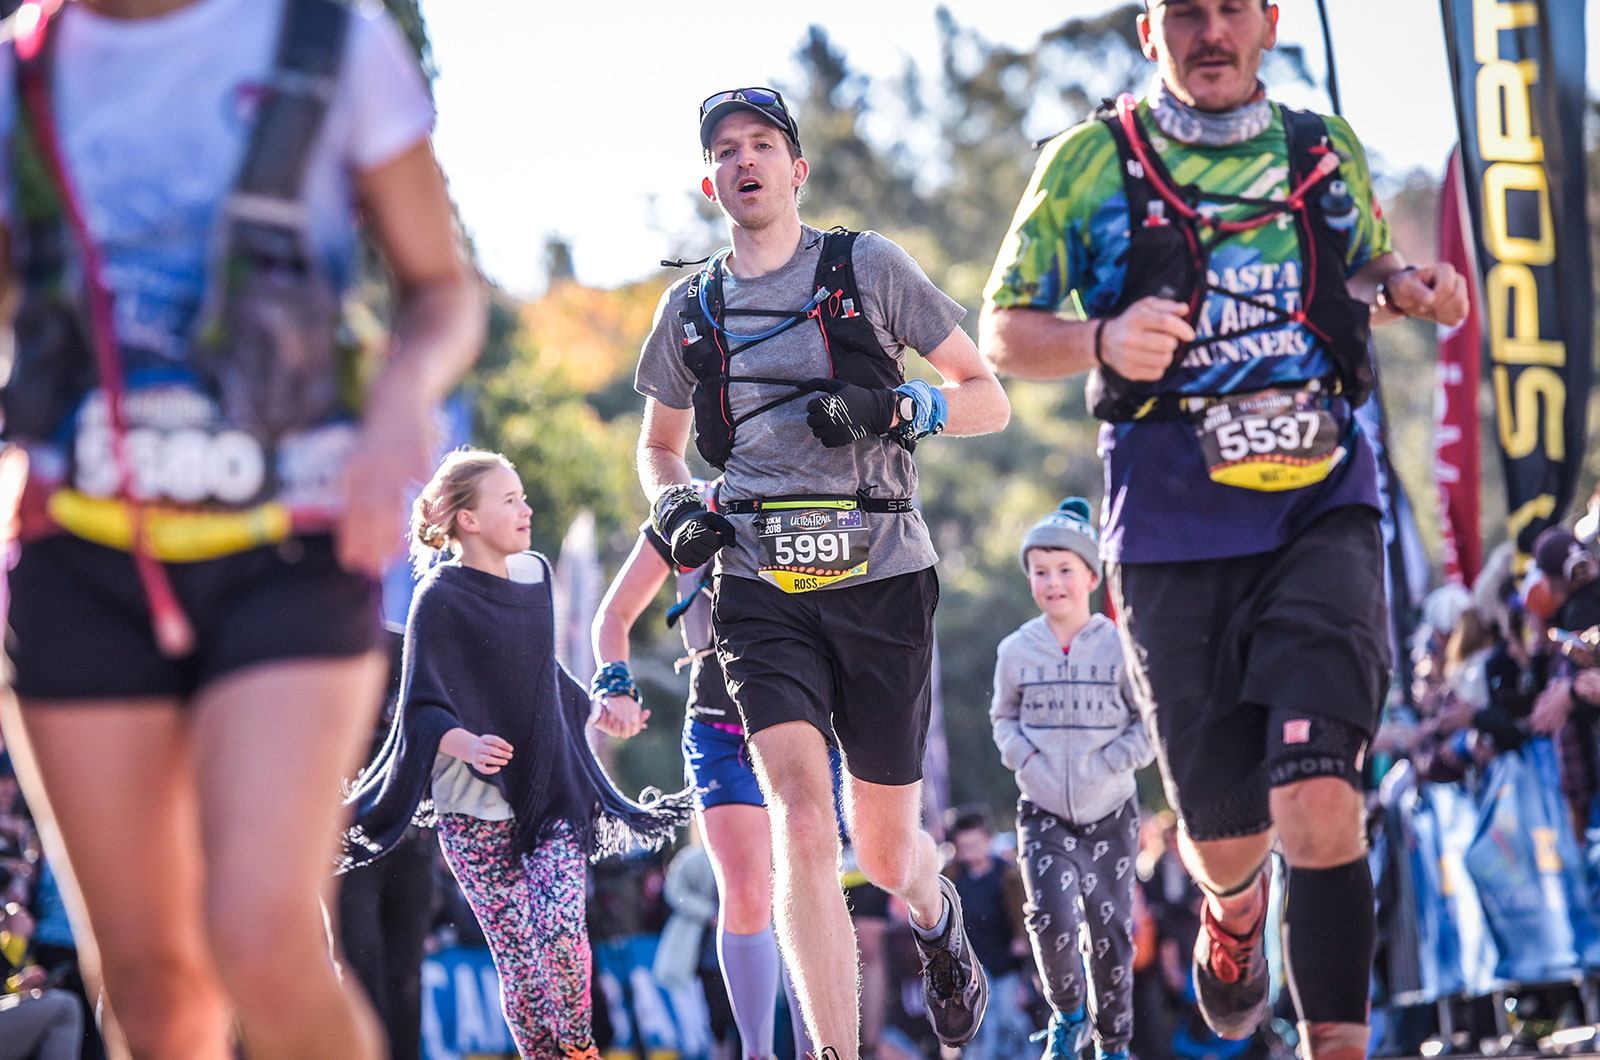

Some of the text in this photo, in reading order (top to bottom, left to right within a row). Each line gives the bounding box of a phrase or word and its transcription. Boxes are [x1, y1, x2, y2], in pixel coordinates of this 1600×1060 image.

[1216, 411, 1320, 461] 5537
[764, 523, 782, 535] 2018
[775, 532, 850, 565] 5991
[794, 577, 818, 591] ROSS
